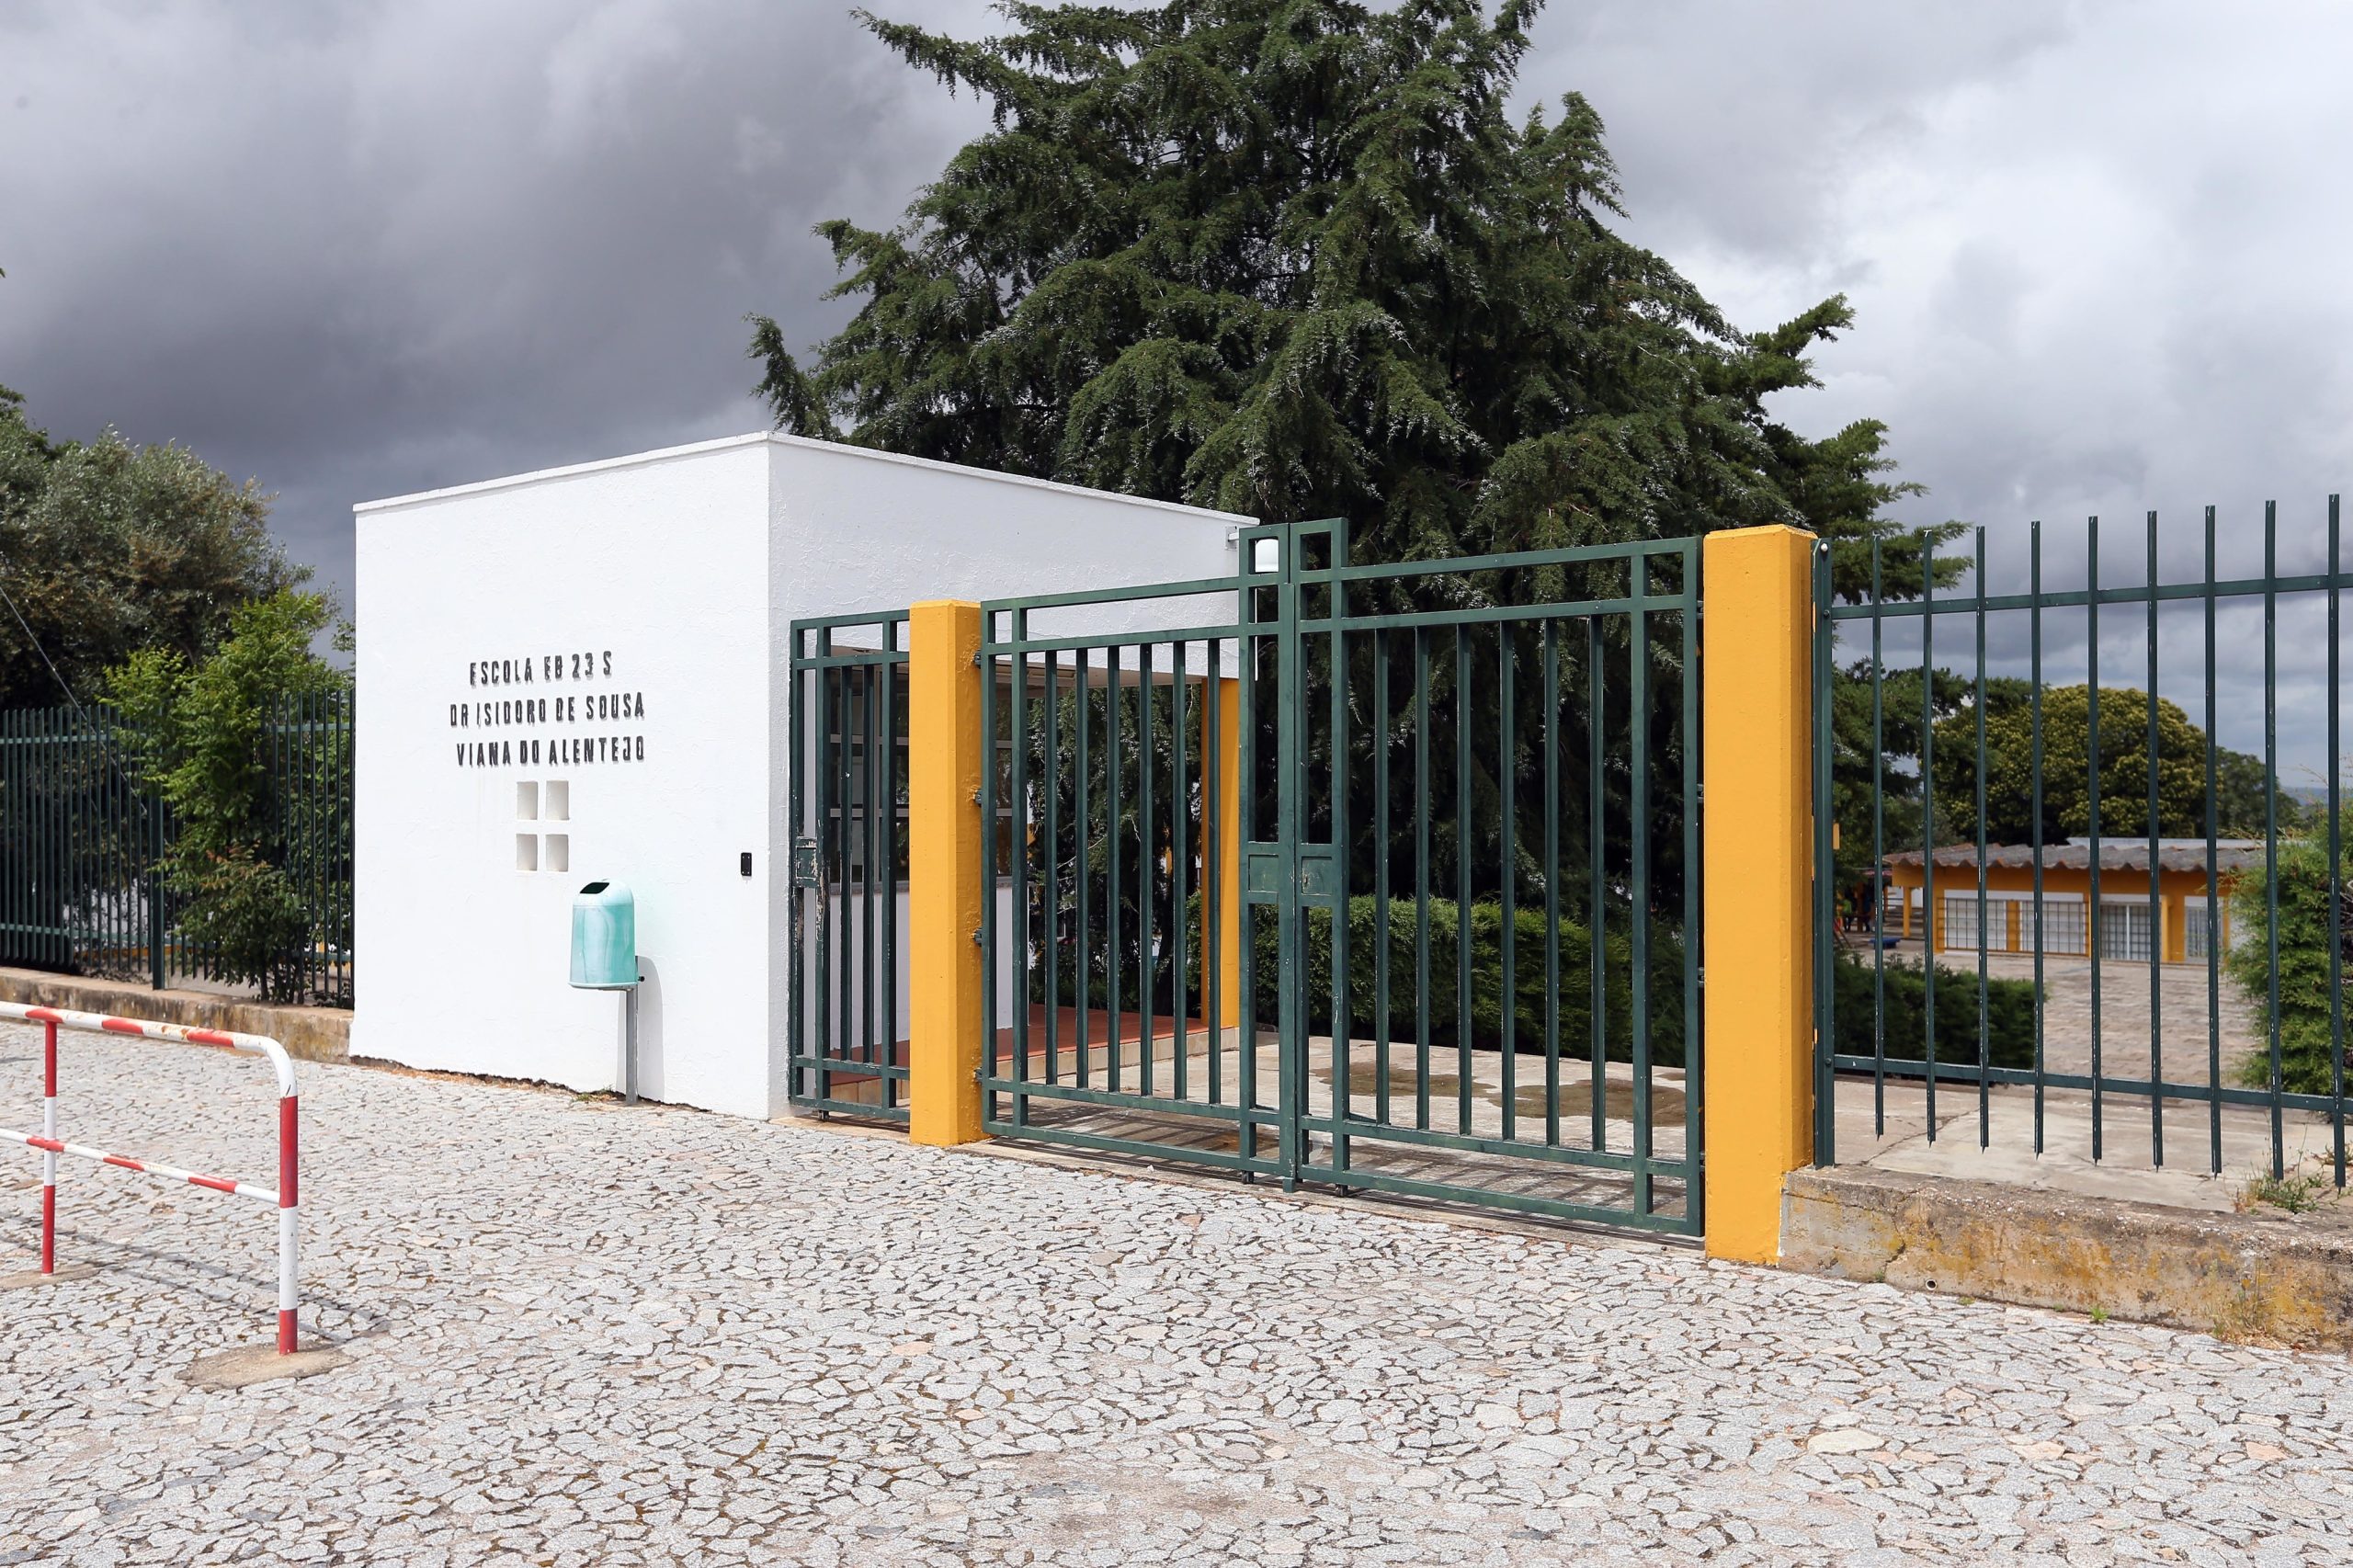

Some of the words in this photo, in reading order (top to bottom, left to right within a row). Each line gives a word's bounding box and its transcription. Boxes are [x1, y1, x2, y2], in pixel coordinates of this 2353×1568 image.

[470, 657, 533, 687] ESCOLA
[449, 703, 469, 727] DR
[476, 699, 546, 726] ISIDORO
[555, 696, 575, 722] DE
[585, 691, 644, 720] SOUSA
[456, 740, 511, 767] VIANA
[519, 739, 540, 765] DO
[549, 735, 644, 766] ALENTEJO
